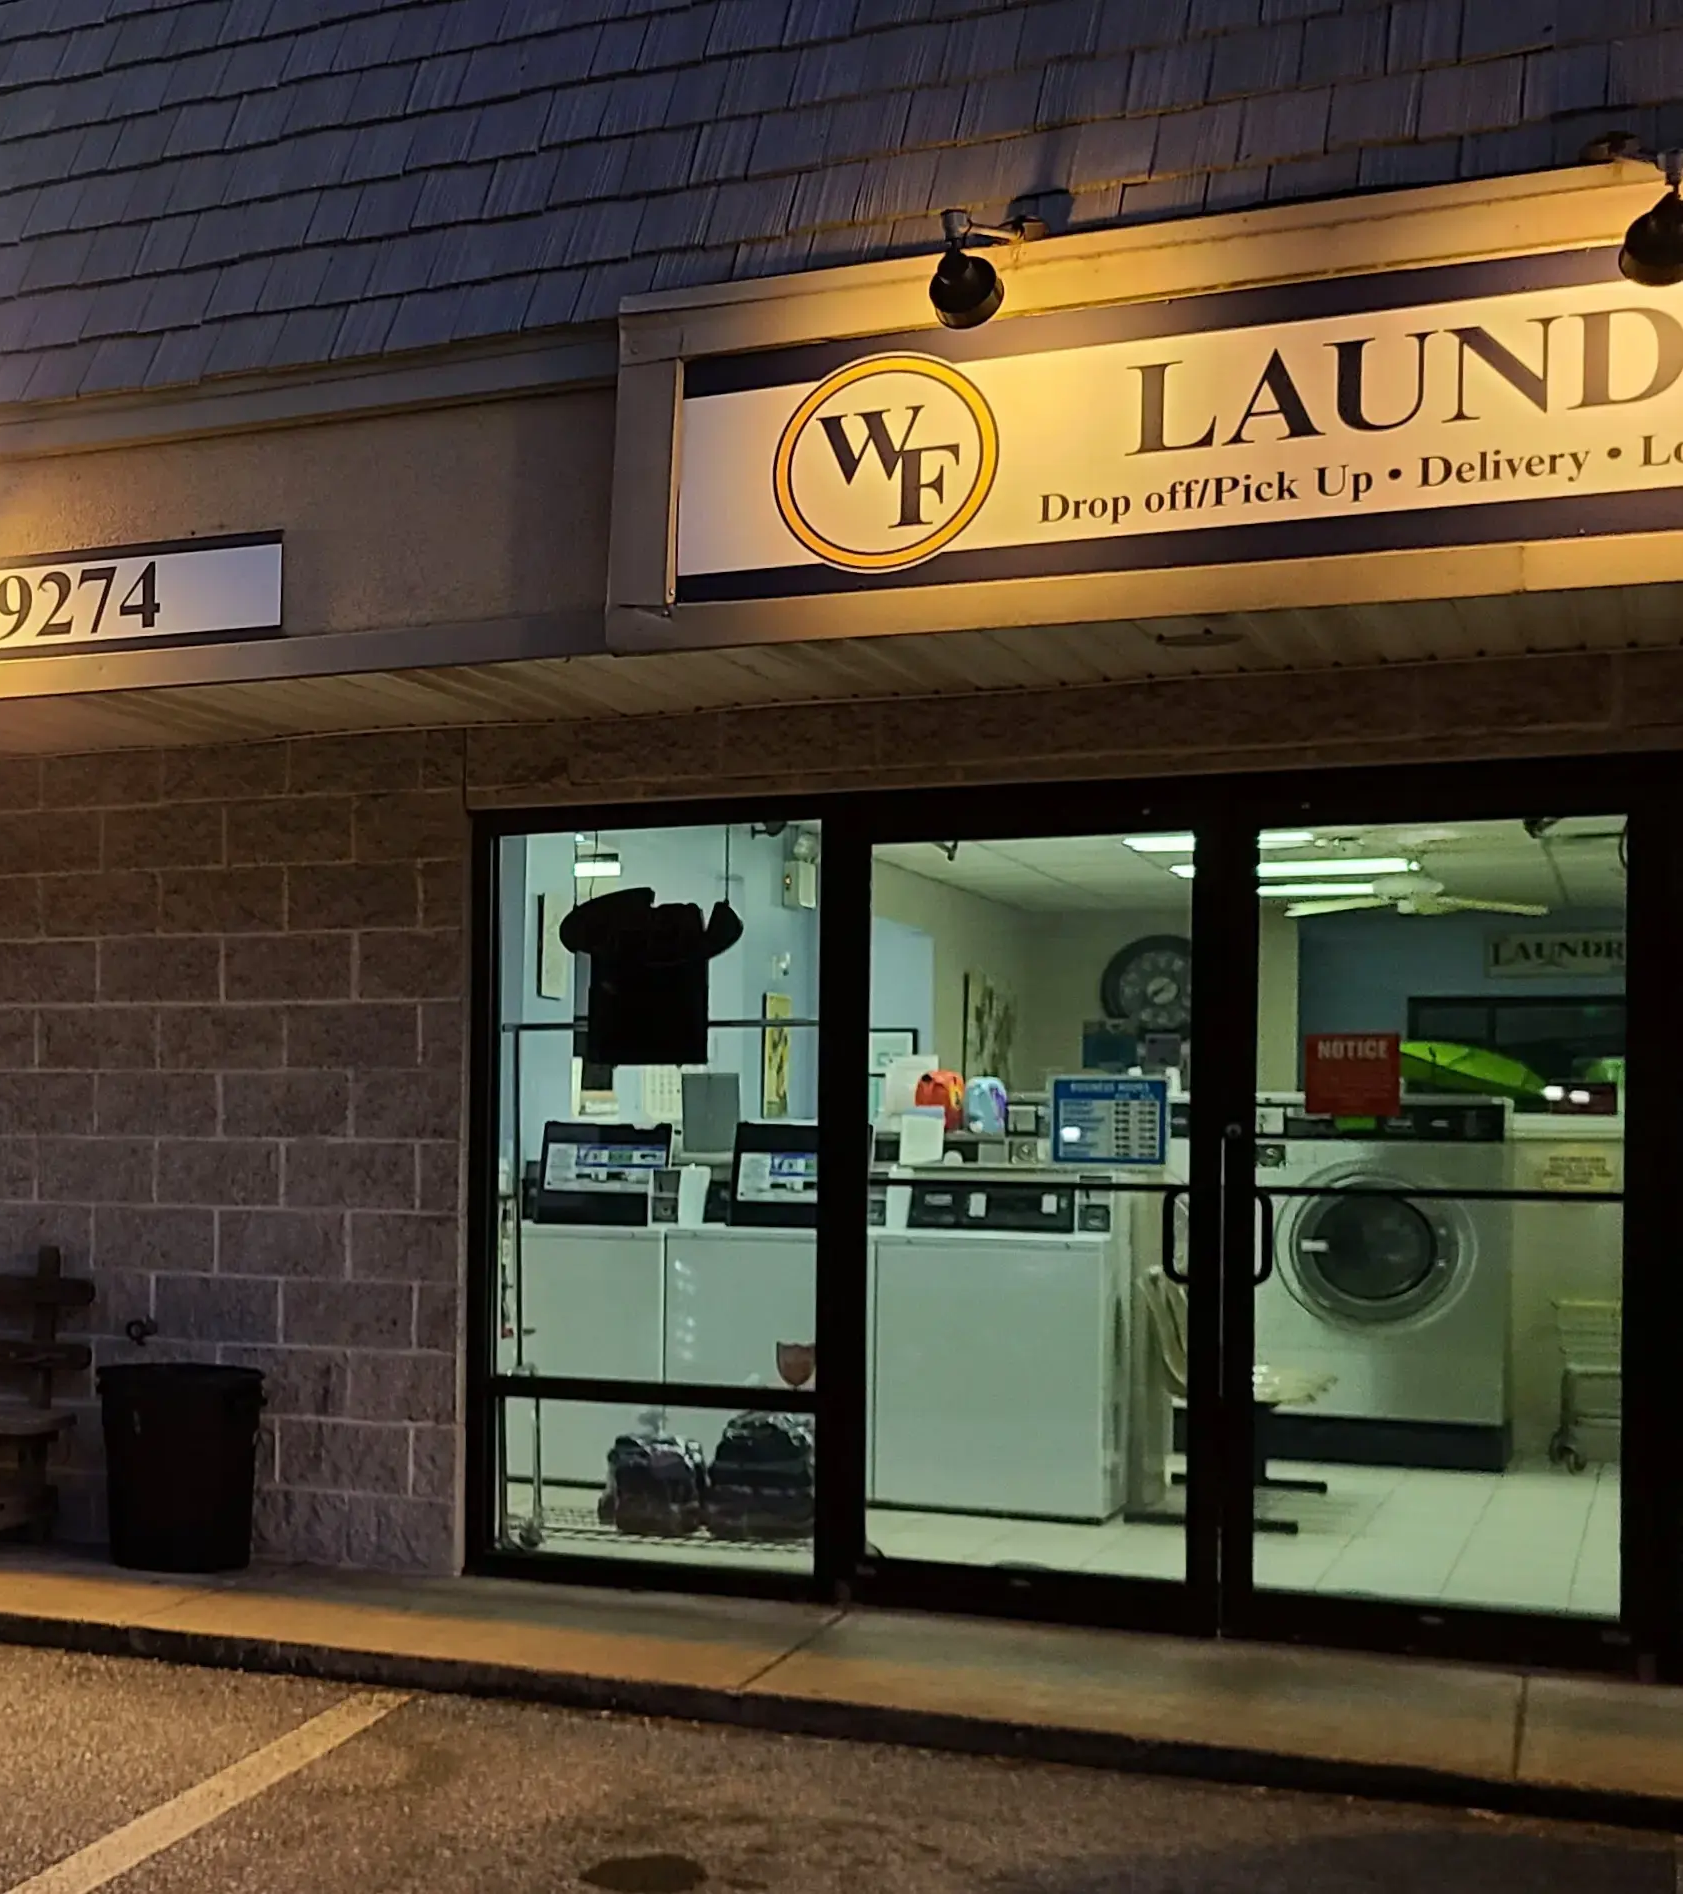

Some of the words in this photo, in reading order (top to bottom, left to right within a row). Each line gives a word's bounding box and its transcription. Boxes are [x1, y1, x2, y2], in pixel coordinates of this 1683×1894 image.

[1124, 307, 1683, 457] LAUND
[1037, 493, 1131, 525] Drop
[1144, 471, 1300, 511] off/Pick
[1312, 464, 1373, 503] Up
[1417, 449, 1591, 489] Delivery
[1318, 1040, 1388, 1060] NOTICE
